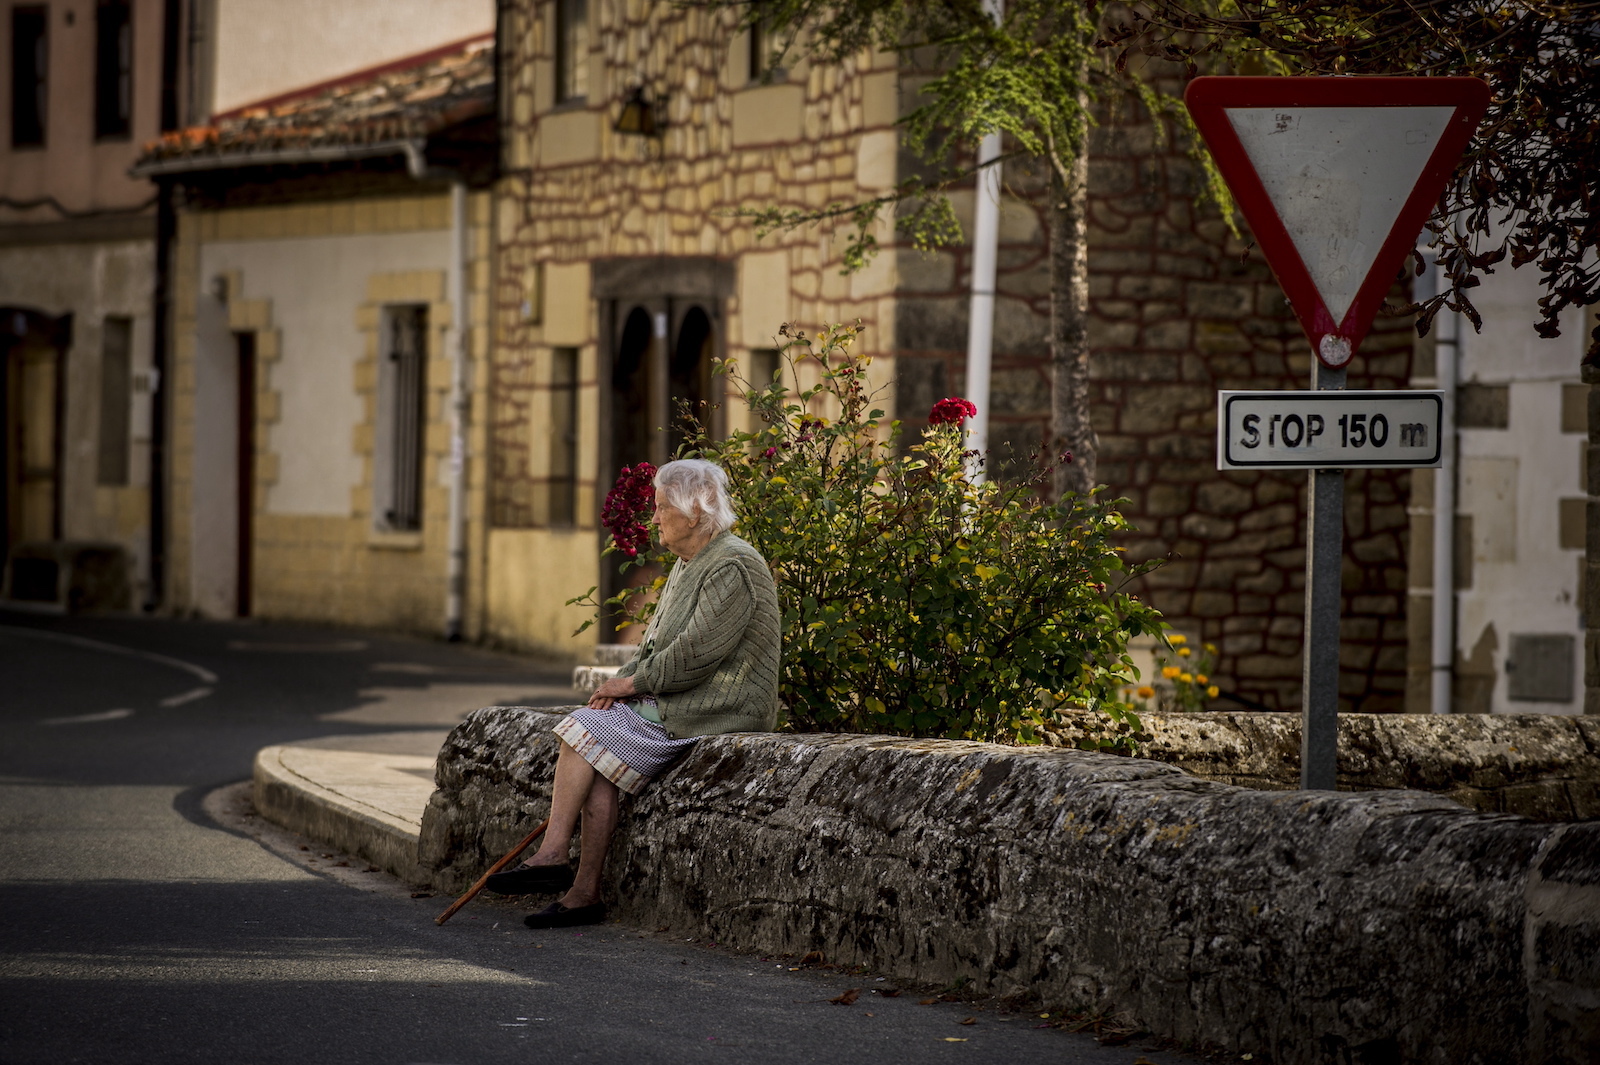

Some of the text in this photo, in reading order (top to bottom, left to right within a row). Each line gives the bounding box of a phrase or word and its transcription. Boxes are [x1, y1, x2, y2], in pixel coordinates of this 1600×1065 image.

[1240, 413, 1428, 449] STOP 150 m
